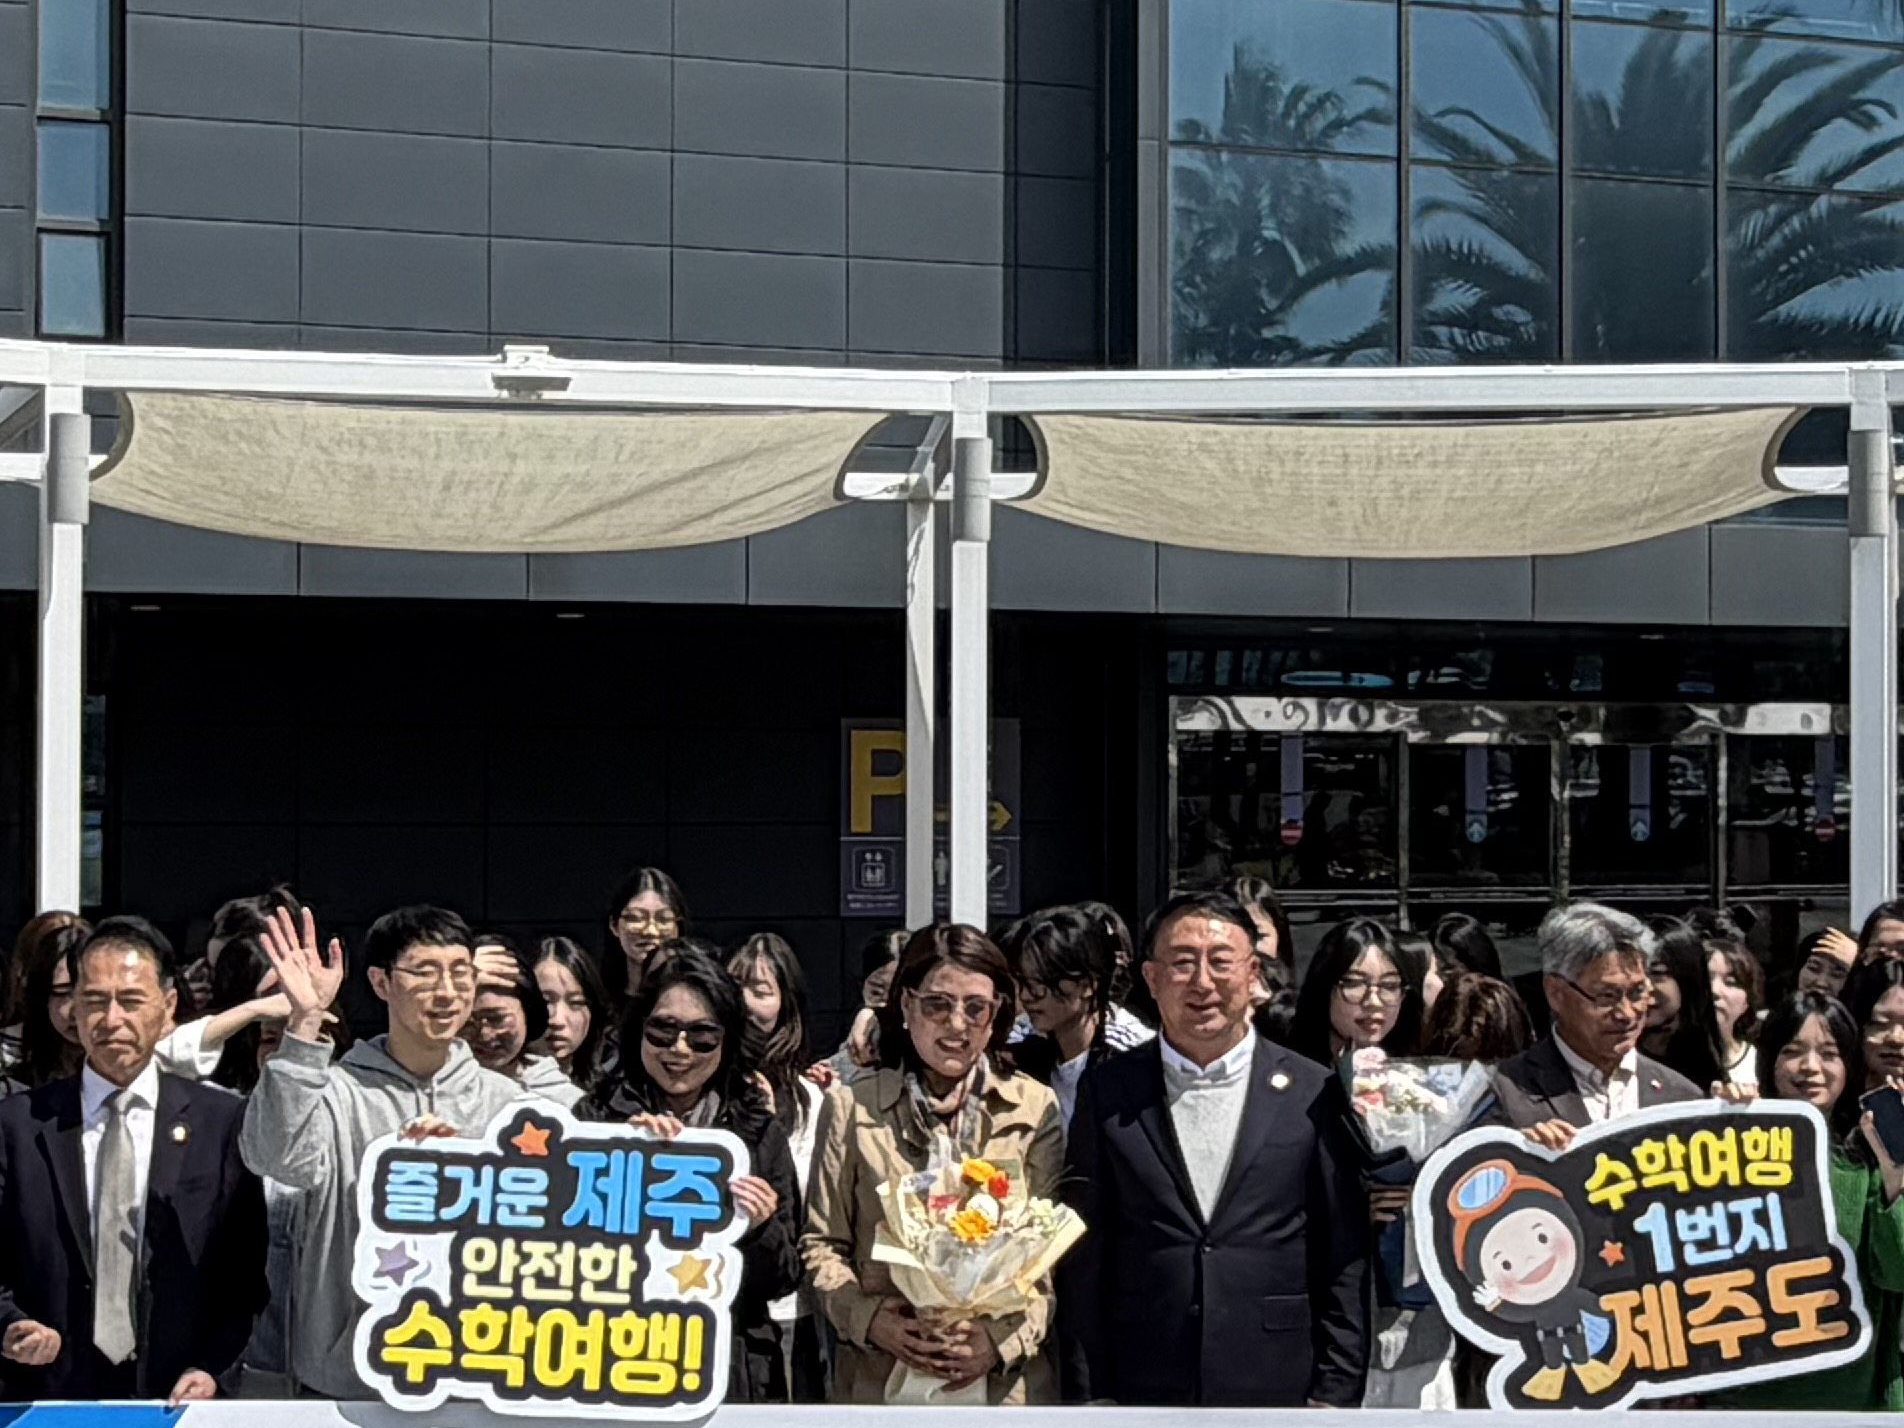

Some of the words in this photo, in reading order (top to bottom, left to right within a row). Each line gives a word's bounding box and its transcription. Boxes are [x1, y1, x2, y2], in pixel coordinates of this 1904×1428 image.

[850, 729, 907, 834] P
[384, 1161, 549, 1229] 즐거운
[562, 1149, 722, 1238] 제주
[1584, 1126, 1793, 1211] 수학여행
[461, 1236, 638, 1304] 안전한
[1632, 1191, 1788, 1273] 1번지
[381, 1299, 704, 1395] 수학여행!
[1598, 1256, 1850, 1374] 제주도
